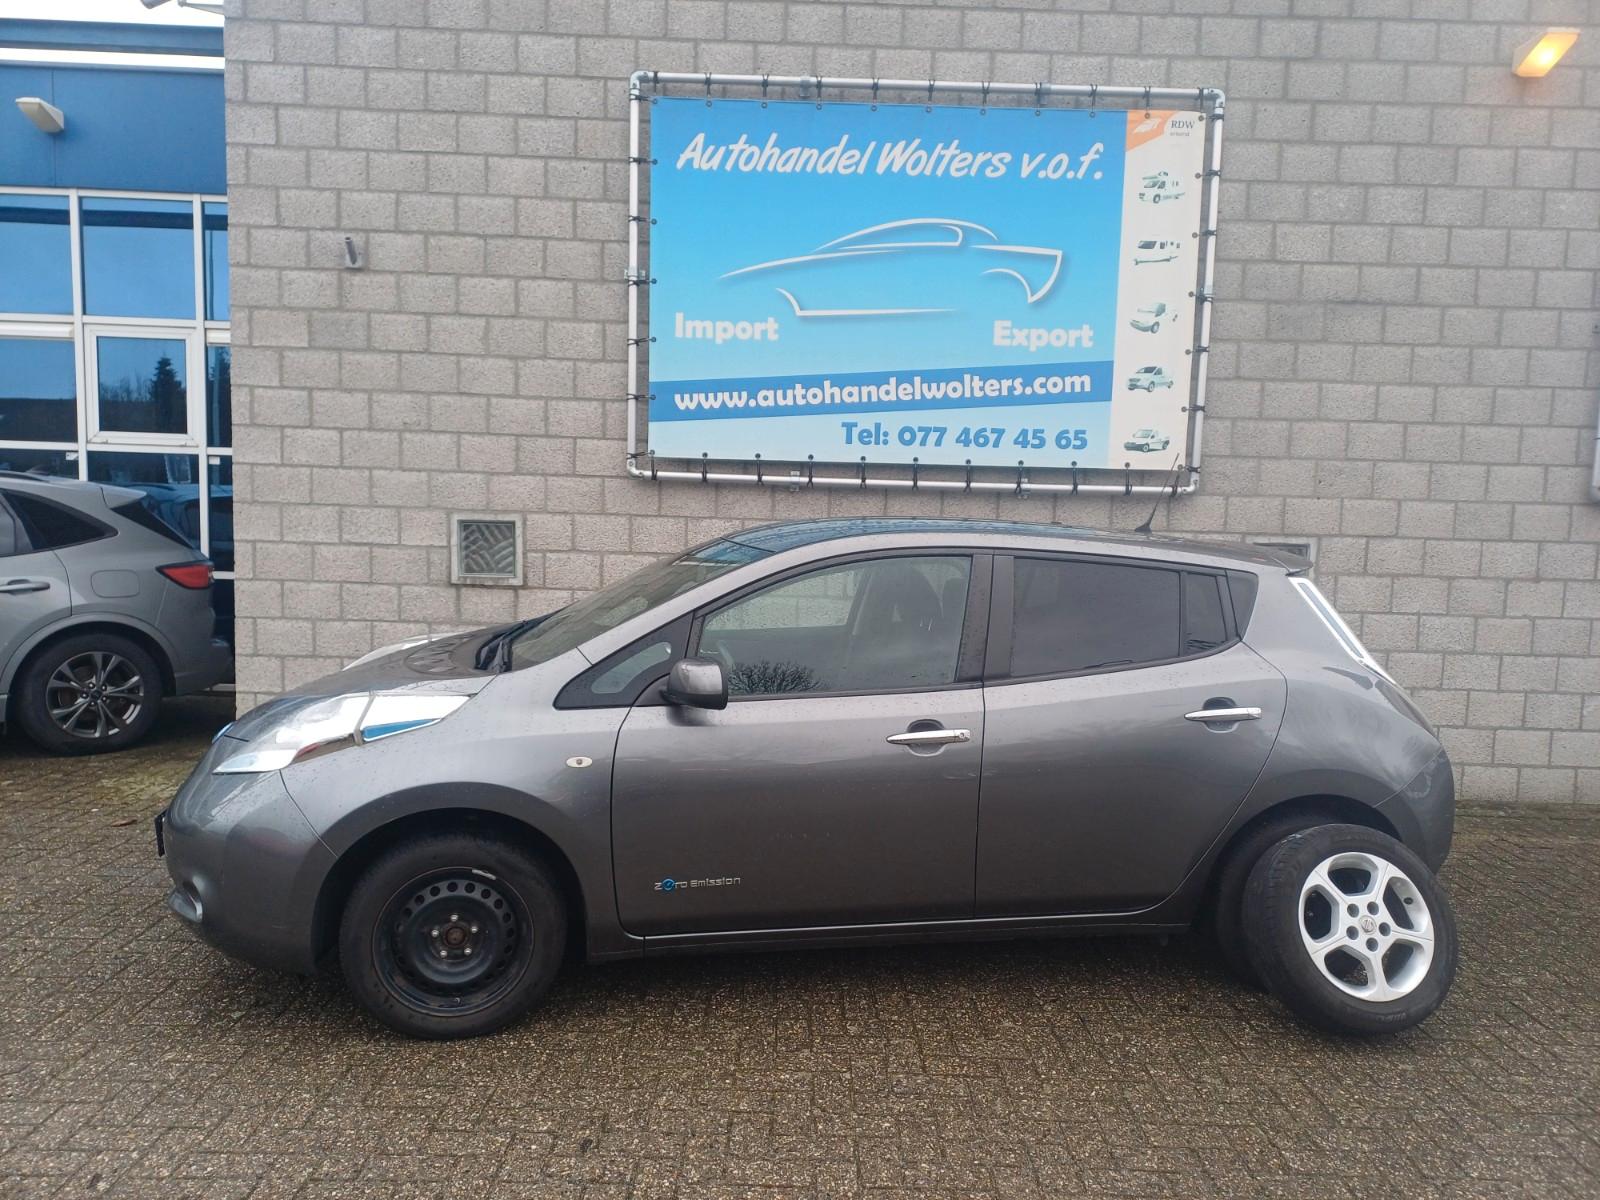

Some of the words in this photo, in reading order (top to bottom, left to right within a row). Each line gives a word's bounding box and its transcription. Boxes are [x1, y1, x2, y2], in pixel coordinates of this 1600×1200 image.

[1171, 120, 1195, 129] RDW
[676, 133, 875, 175] Autohandel
[876, 140, 1010, 177] Wolters
[1020, 142, 1103, 179] v.o.f.
[674, 312, 779, 344] Import
[993, 320, 1094, 352] Export
[674, 373, 1091, 409] www.autohandelwolters.com
[841, 422, 889, 446] Tel:
[897, 425, 947, 448] 077
[955, 426, 1005, 448] 467
[1013, 428, 1047, 449] 45
[1055, 428, 1088, 449] 65
